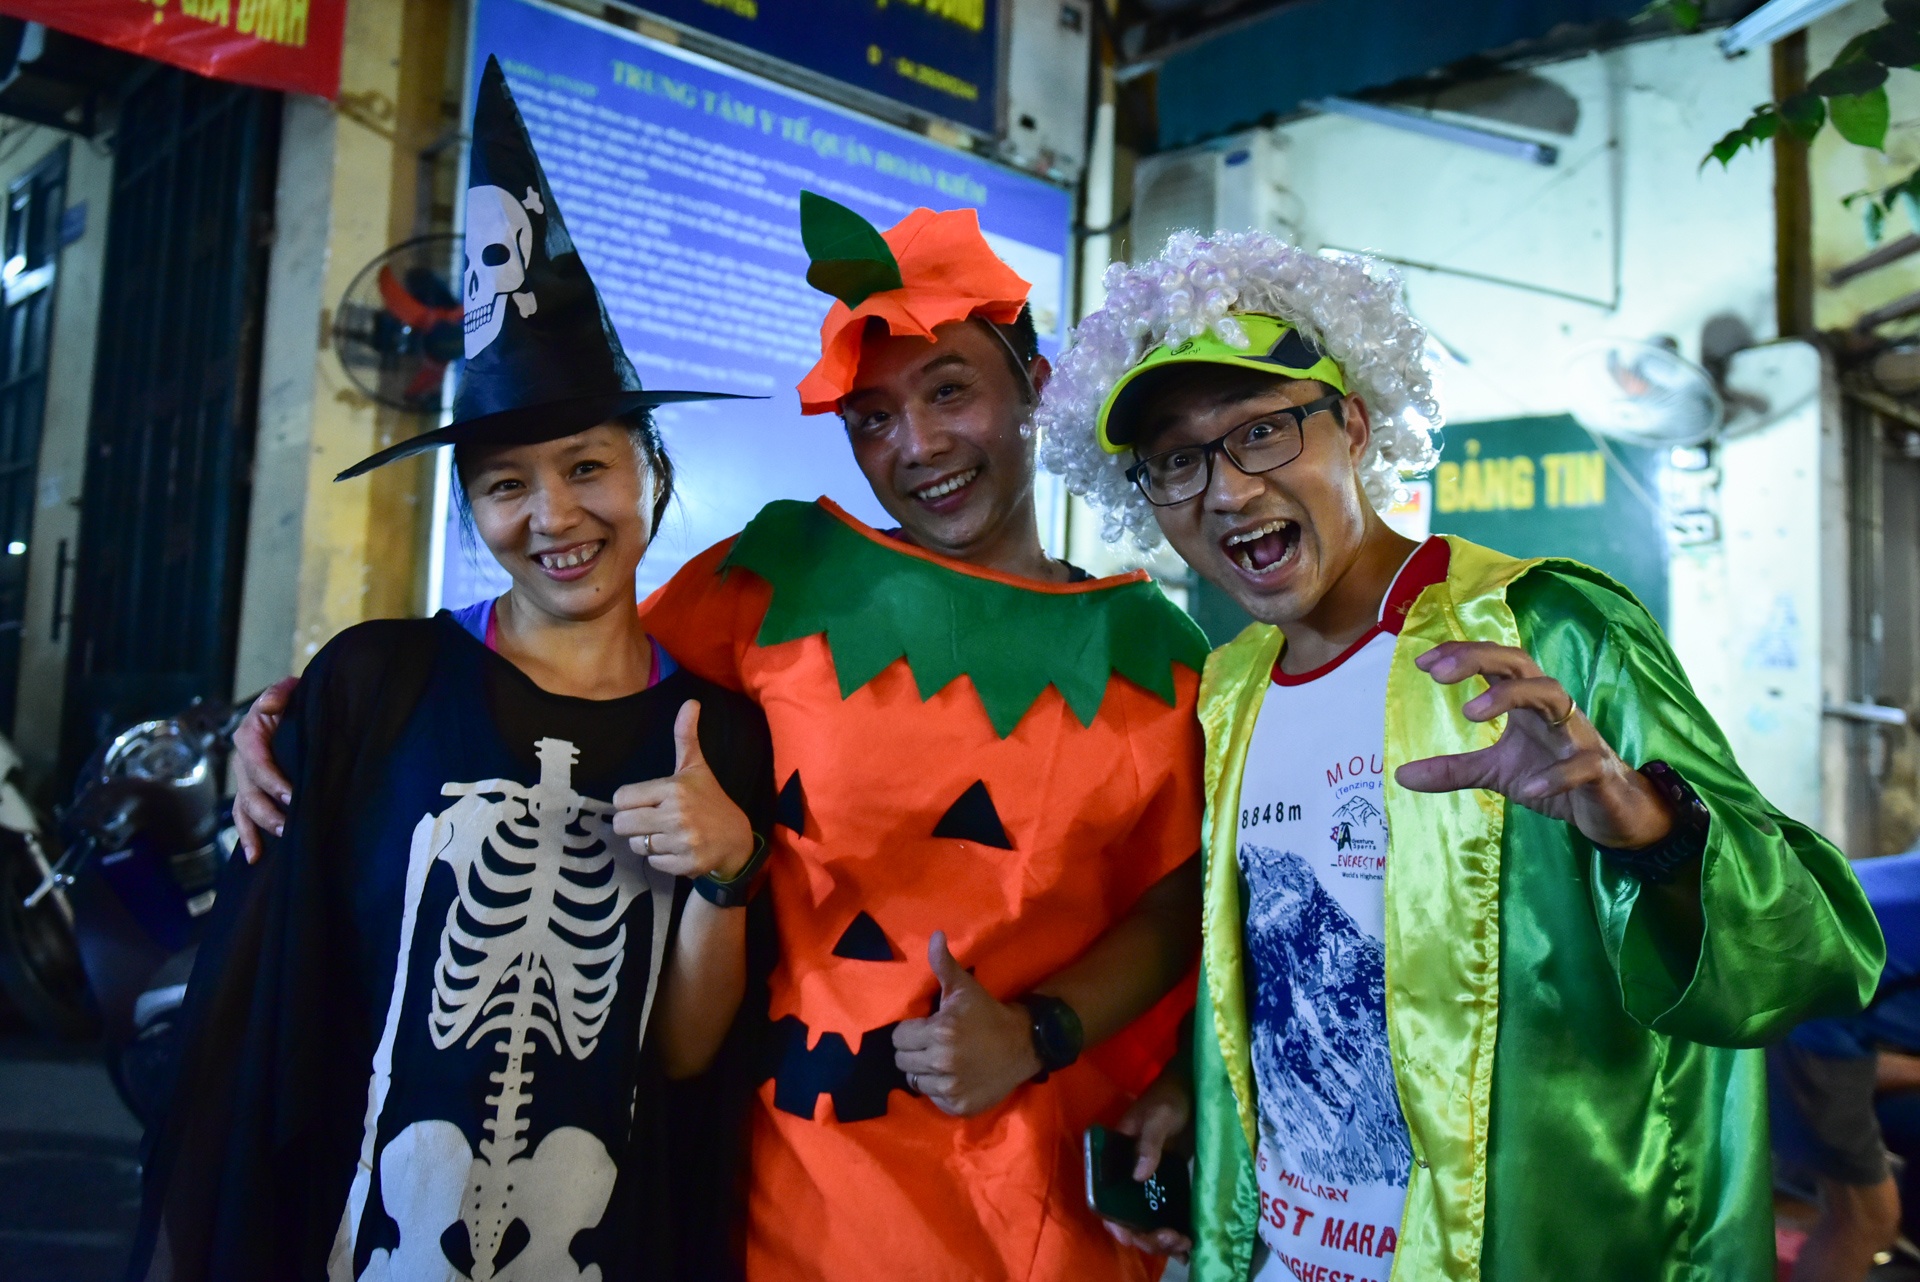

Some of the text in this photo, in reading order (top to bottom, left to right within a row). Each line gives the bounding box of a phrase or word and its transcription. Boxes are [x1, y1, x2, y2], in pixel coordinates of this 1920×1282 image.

[612, 59, 696, 110] TRUNG
[703, 89, 755, 128] TÂM
[759, 109, 774, 135] Y
[1436, 438, 1606, 513] BẢNG TIN
[1241, 801, 1302, 830] 8848m
[1338, 854, 1375, 871] EVEREST
[1279, 1169, 1349, 1203] HILLARY
[1320, 1217, 1398, 1259] MARA
